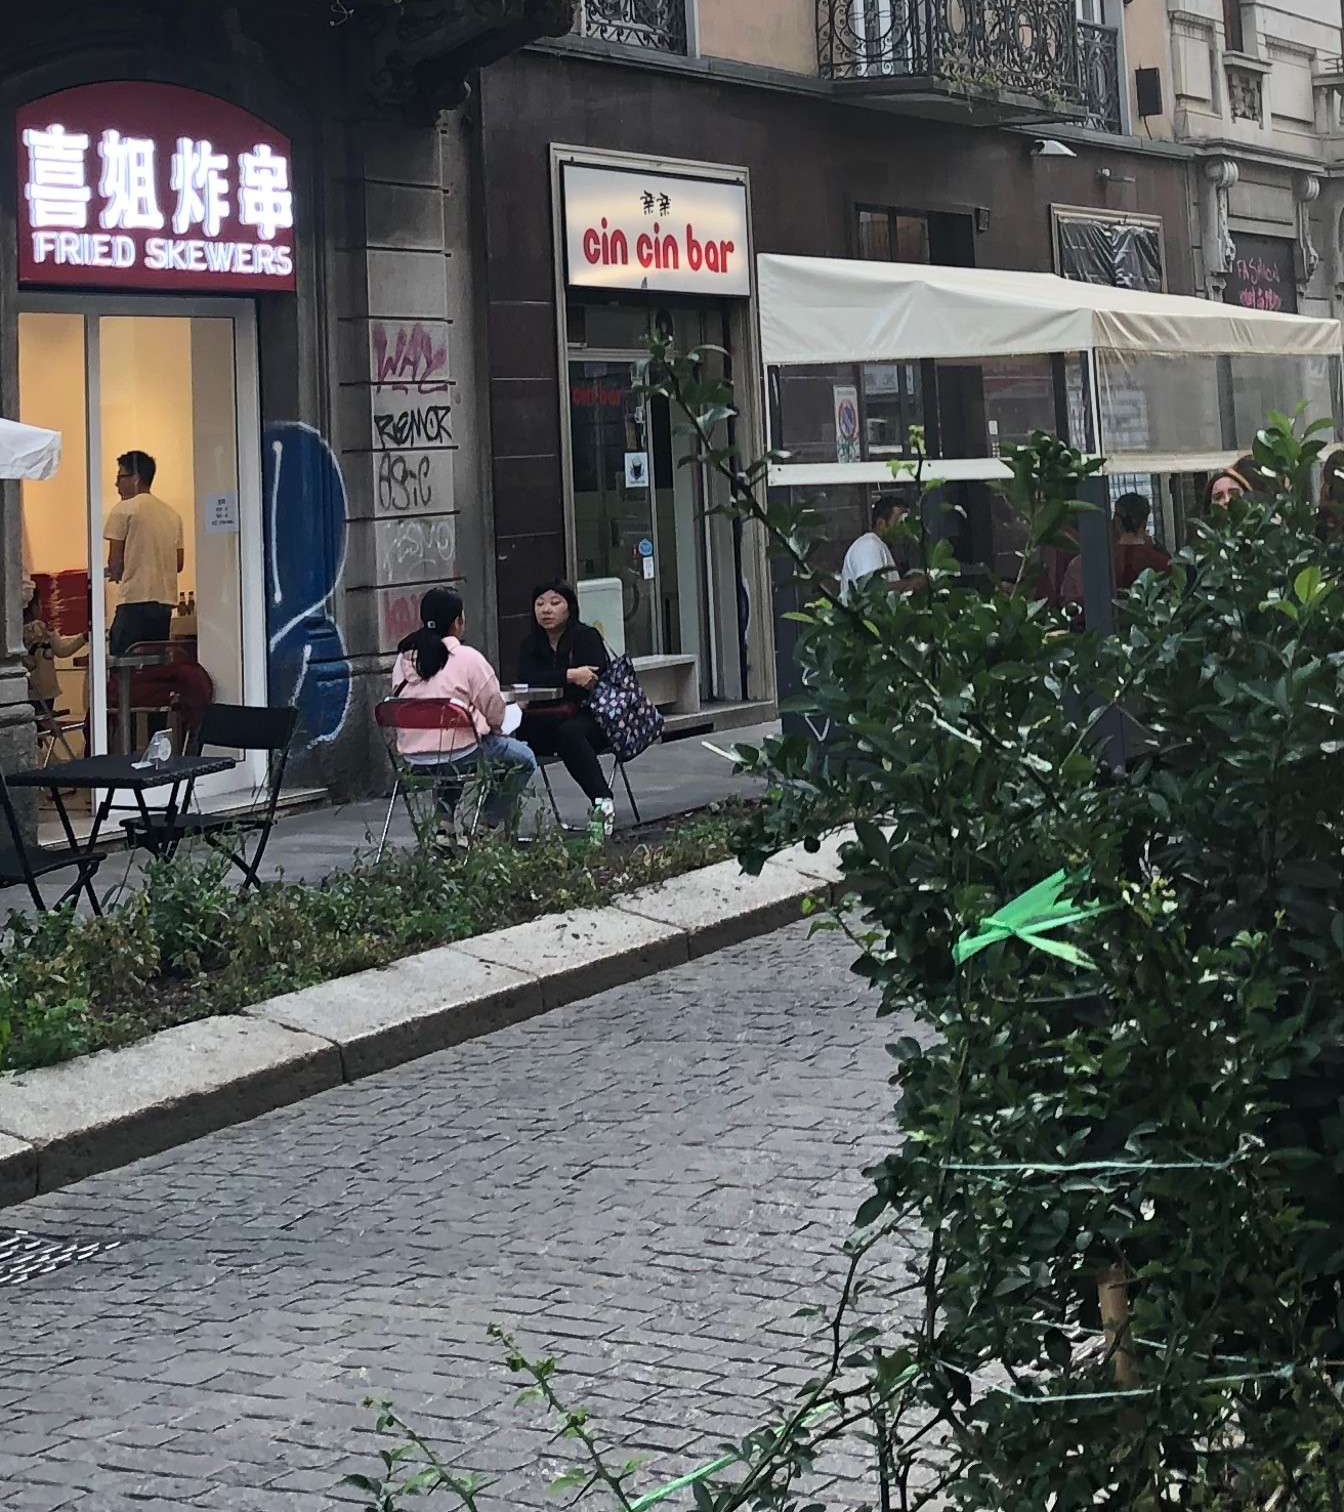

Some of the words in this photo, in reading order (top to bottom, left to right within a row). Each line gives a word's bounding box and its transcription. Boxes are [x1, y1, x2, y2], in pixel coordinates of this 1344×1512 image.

[22, 123, 294, 239] 喜姐炸串
[32, 231, 136, 268] FRIED
[144, 237, 294, 276] SKEWERS
[583, 217, 628, 266] cin
[636, 221, 679, 270] cin
[686, 223, 735, 274] bar
